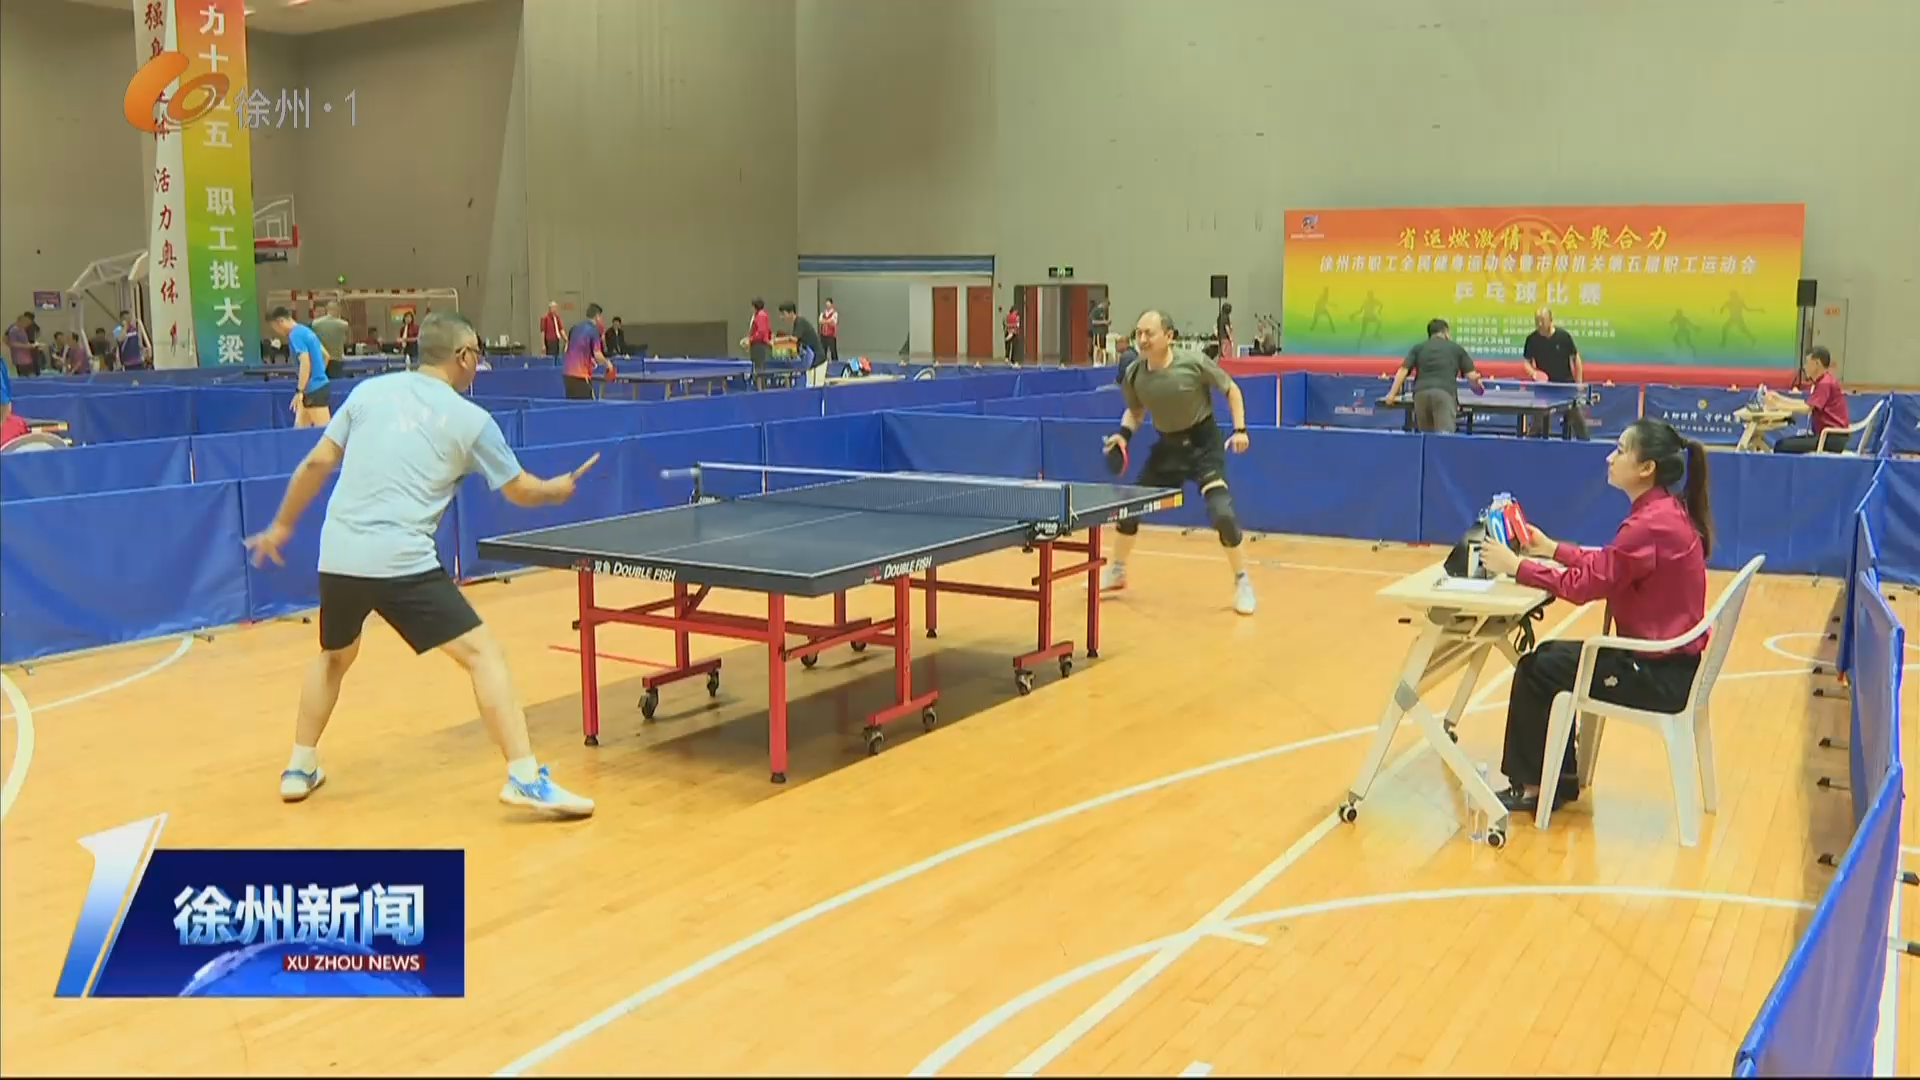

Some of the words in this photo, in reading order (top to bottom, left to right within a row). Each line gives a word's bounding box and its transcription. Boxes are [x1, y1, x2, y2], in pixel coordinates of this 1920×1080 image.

[1398, 224, 1522, 251] 省运燃激情
[1535, 224, 1668, 251] 工会聚合力
[205, 186, 244, 364] 职工挑大梁
[1453, 281, 1602, 304] 乒乓球比赛
[613, 560, 651, 579] DOUBLE
[653, 567, 677, 582] FISH
[884, 560, 916, 580] DOUBLE
[915, 555, 933, 572] FISH
